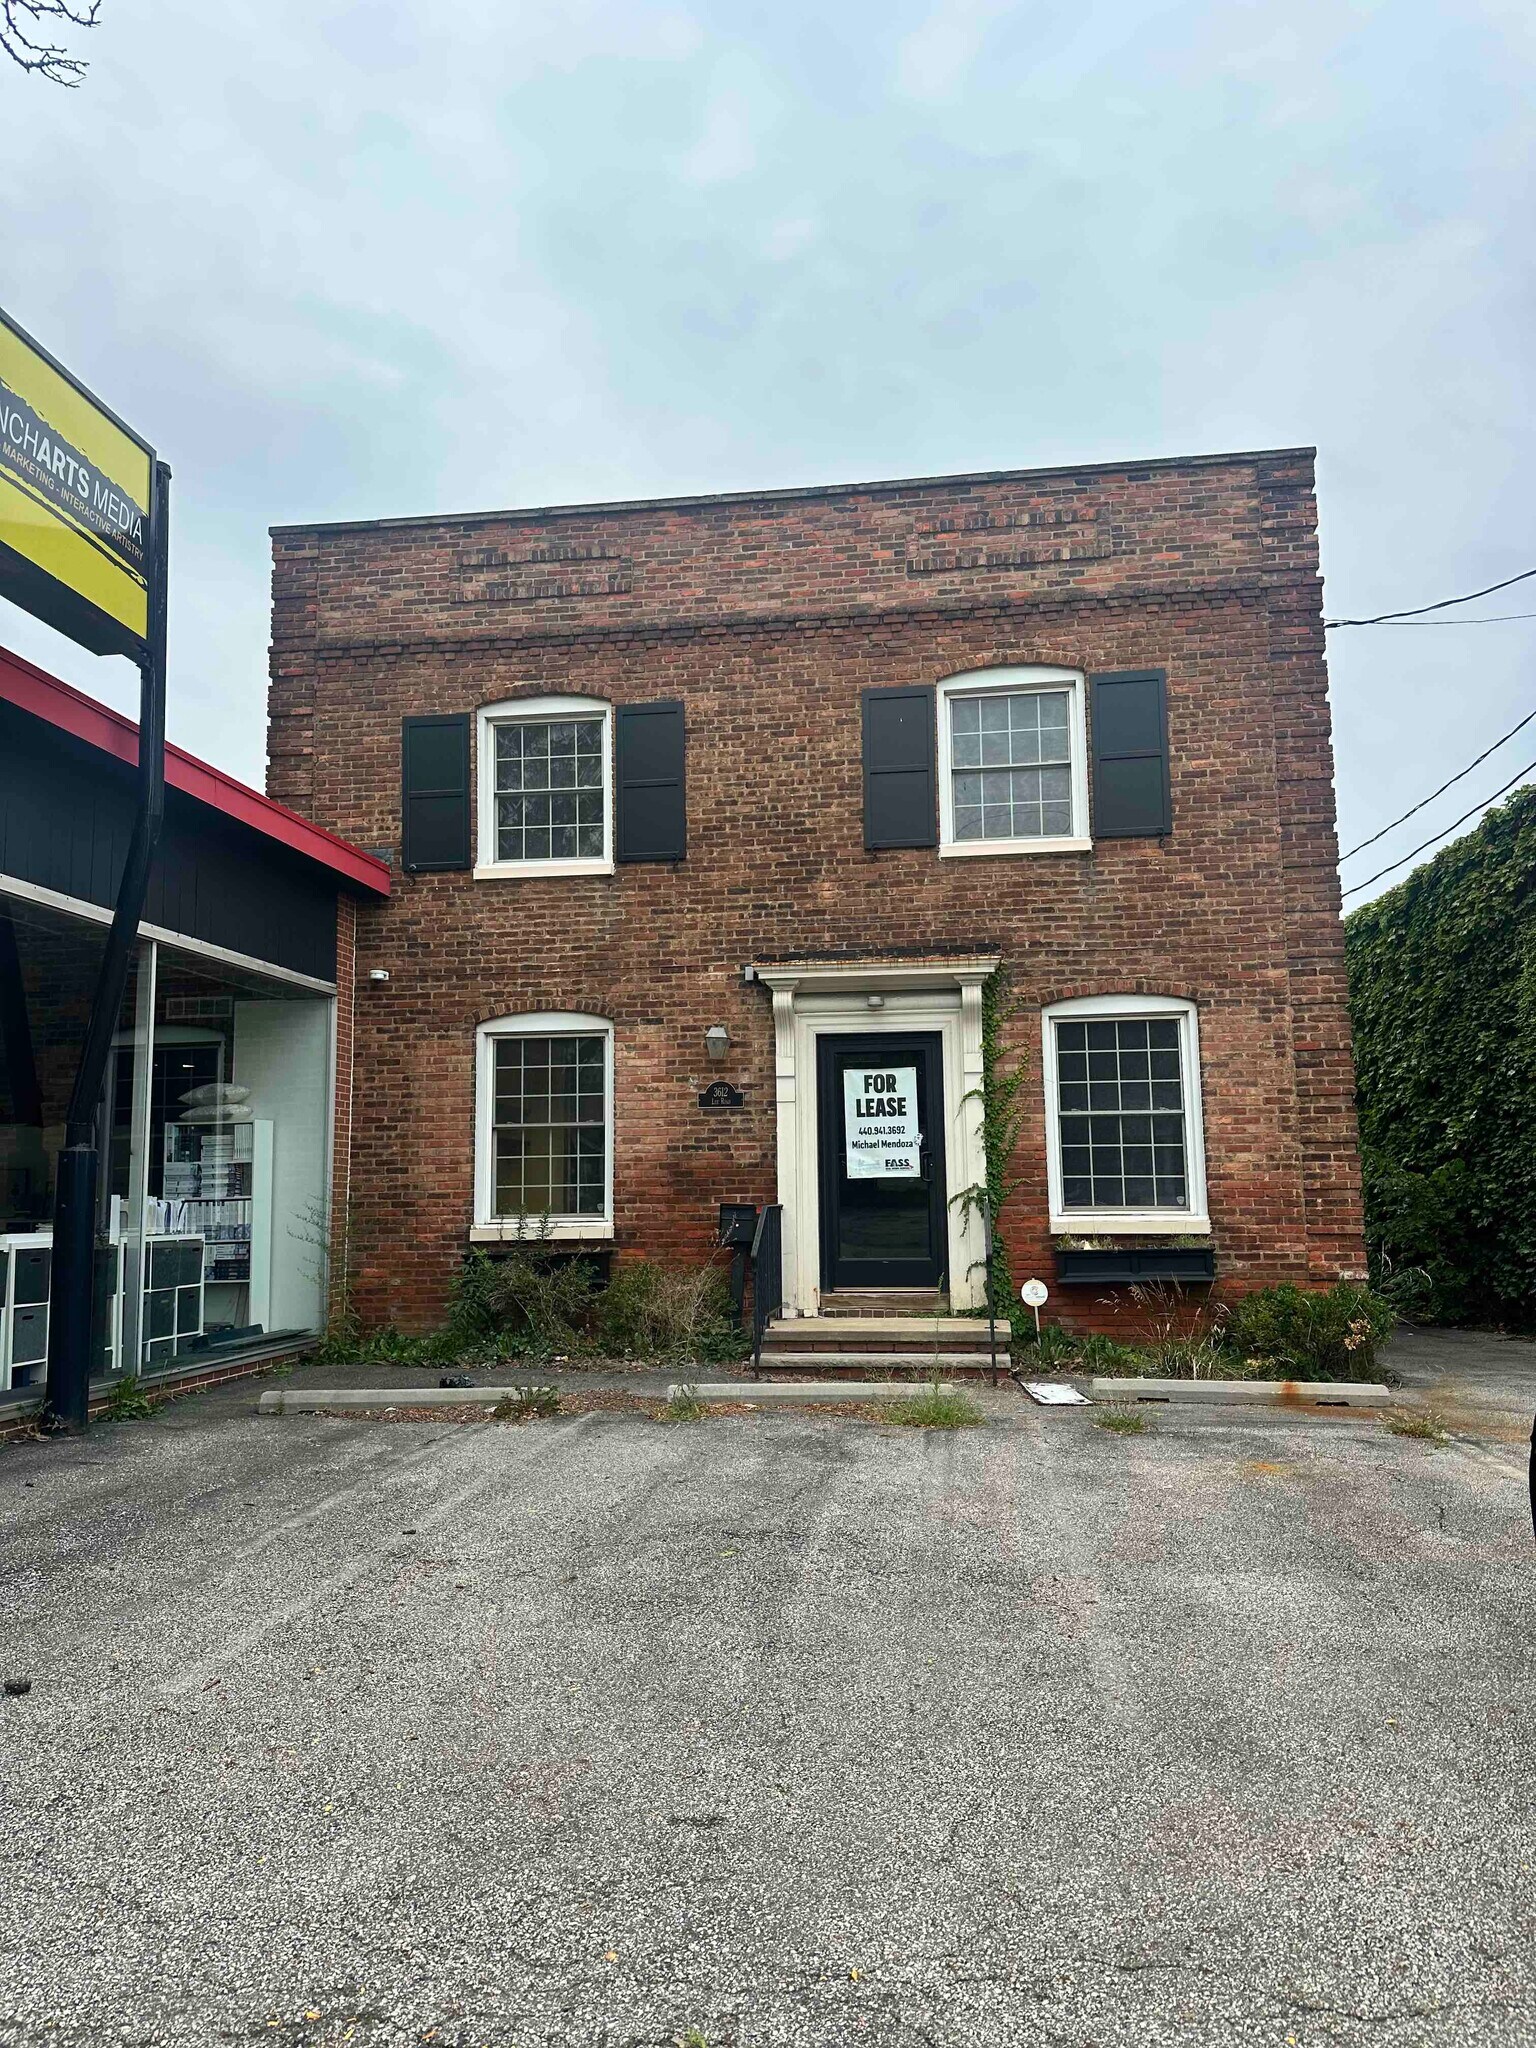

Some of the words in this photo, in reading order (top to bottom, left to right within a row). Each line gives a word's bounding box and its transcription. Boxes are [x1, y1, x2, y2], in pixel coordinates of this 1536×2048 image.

[2, 441, 55, 490] MARKETING
[60, 486, 111, 535] INTERACTIVE
[111, 528, 144, 562] ARTISTRY
[93, 480, 143, 545] MEDIA
[713, 1086, 729, 1097] 3612
[863, 1074, 897, 1094] FOR
[855, 1097, 907, 1118] LEASE
[858, 1126, 906, 1136] 440.941.3692
[851, 1140, 880, 1149] Michael
[880, 1139, 914, 1148] Mendoza
[884, 1158, 910, 1167] FASS
